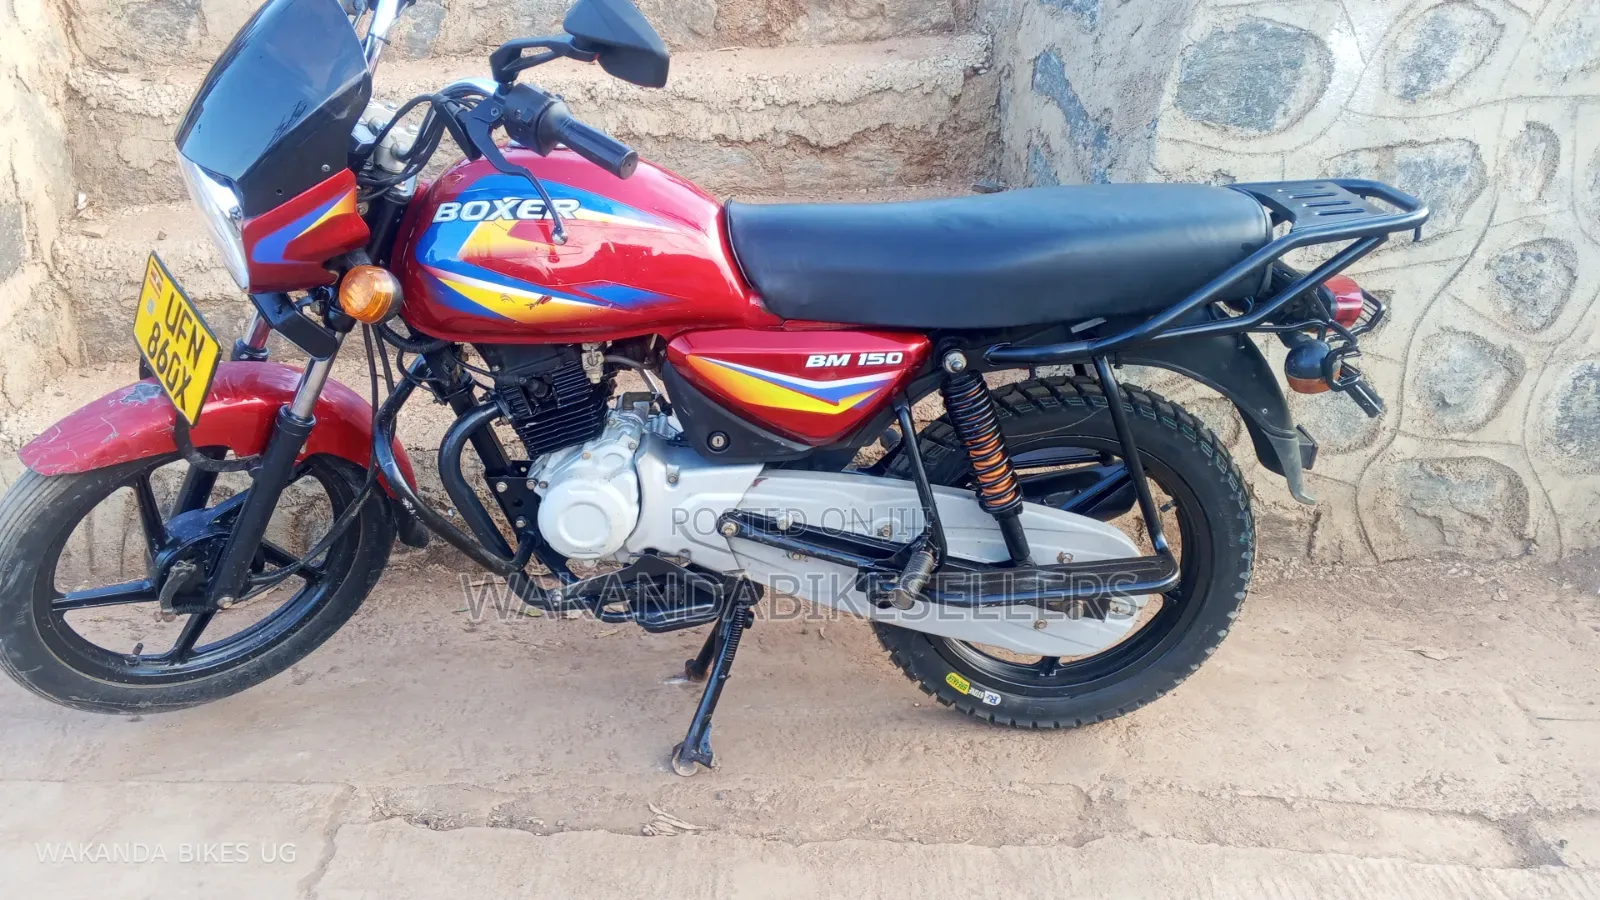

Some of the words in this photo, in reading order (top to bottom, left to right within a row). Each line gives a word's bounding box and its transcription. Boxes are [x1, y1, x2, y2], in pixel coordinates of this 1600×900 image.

[432, 196, 582, 224] BOXER
[165, 291, 206, 370] UFN
[805, 353, 851, 368] BM
[857, 351, 904, 366] 150
